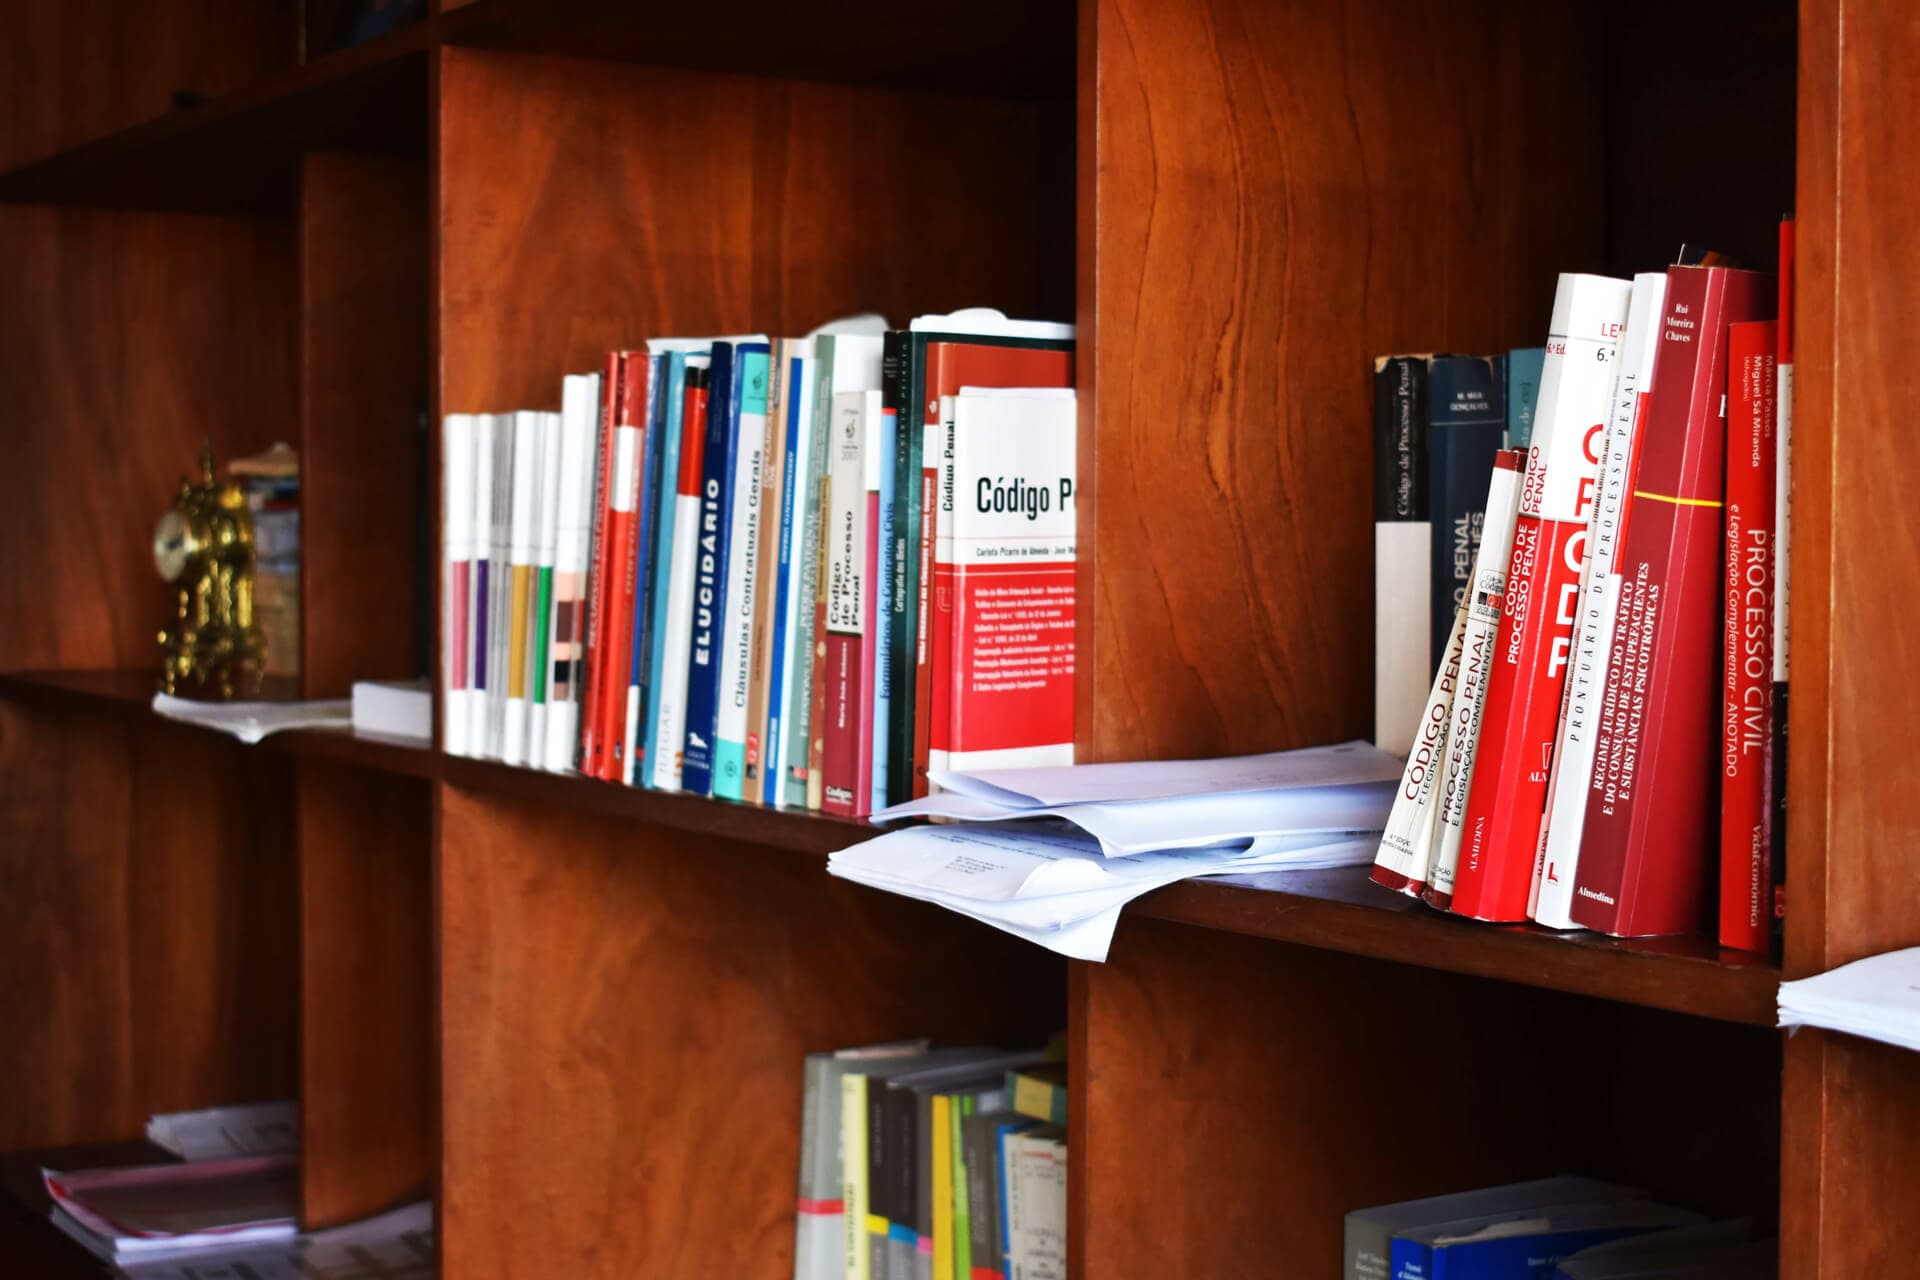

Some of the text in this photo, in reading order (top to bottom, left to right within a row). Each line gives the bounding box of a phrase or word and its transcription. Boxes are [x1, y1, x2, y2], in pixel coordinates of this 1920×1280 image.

[1665, 331, 1690, 342] Chaves
[1667, 316, 1694, 329] Moreira
[1675, 303, 1688, 314] Rui
[1398, 362, 1409, 396] Penal
[1752, 356, 1762, 468] Miguel Sá Miranda
[1764, 355, 1774, 438] Márcia Passos
[944, 420, 955, 459] Penal
[976, 476, 1049, 521] Código
[1522, 446, 1540, 513] CÓDIGO
[1532, 464, 1547, 514] PENAL
[1731, 504, 1739, 513] e
[696, 479, 719, 666] ELUCIDÁRIO
[735, 450, 761, 708] Cláusulas Contratuais Gerais
[841, 511, 853, 626] de Processo
[1453, 512, 1469, 580] PENAL
[1505, 523, 1529, 617] CÓDIGO DE
[1570, 373, 1636, 742] PRONTUÁRIO DE PROCESSO PENAL
[1727, 515, 1741, 587] Legislação
[830, 562, 842, 625] Código
[852, 575, 860, 626] Penal
[1507, 526, 1538, 664] PROCESSO PENAL
[1727, 589, 1741, 692] Complementar
[1743, 529, 1767, 755] PROCESSO CIVIL
[1470, 631, 1495, 736] COMPLEMENTAR
[1593, 581, 1633, 790] REGIME JURÍDICO DO TRÁFICO
[1602, 562, 1649, 816] E DO CONSUMO DE ESTUPEFACIENTES
[1619, 584, 1659, 800] E SUBSTÂNCIAS PSICOTRÓPICAS
[1405, 703, 1446, 800] CÓDIGO
[1441, 707, 1471, 823] PROCESSO
[1464, 629, 1488, 700] PENAL
[1726, 702, 1738, 777] ANOTADO
[1454, 738, 1475, 816] LEGISLAÇÃO
[1451, 819, 1460, 827] E
[1470, 816, 1486, 872] ALMEDINA
[1577, 886, 1614, 905] Almedina
